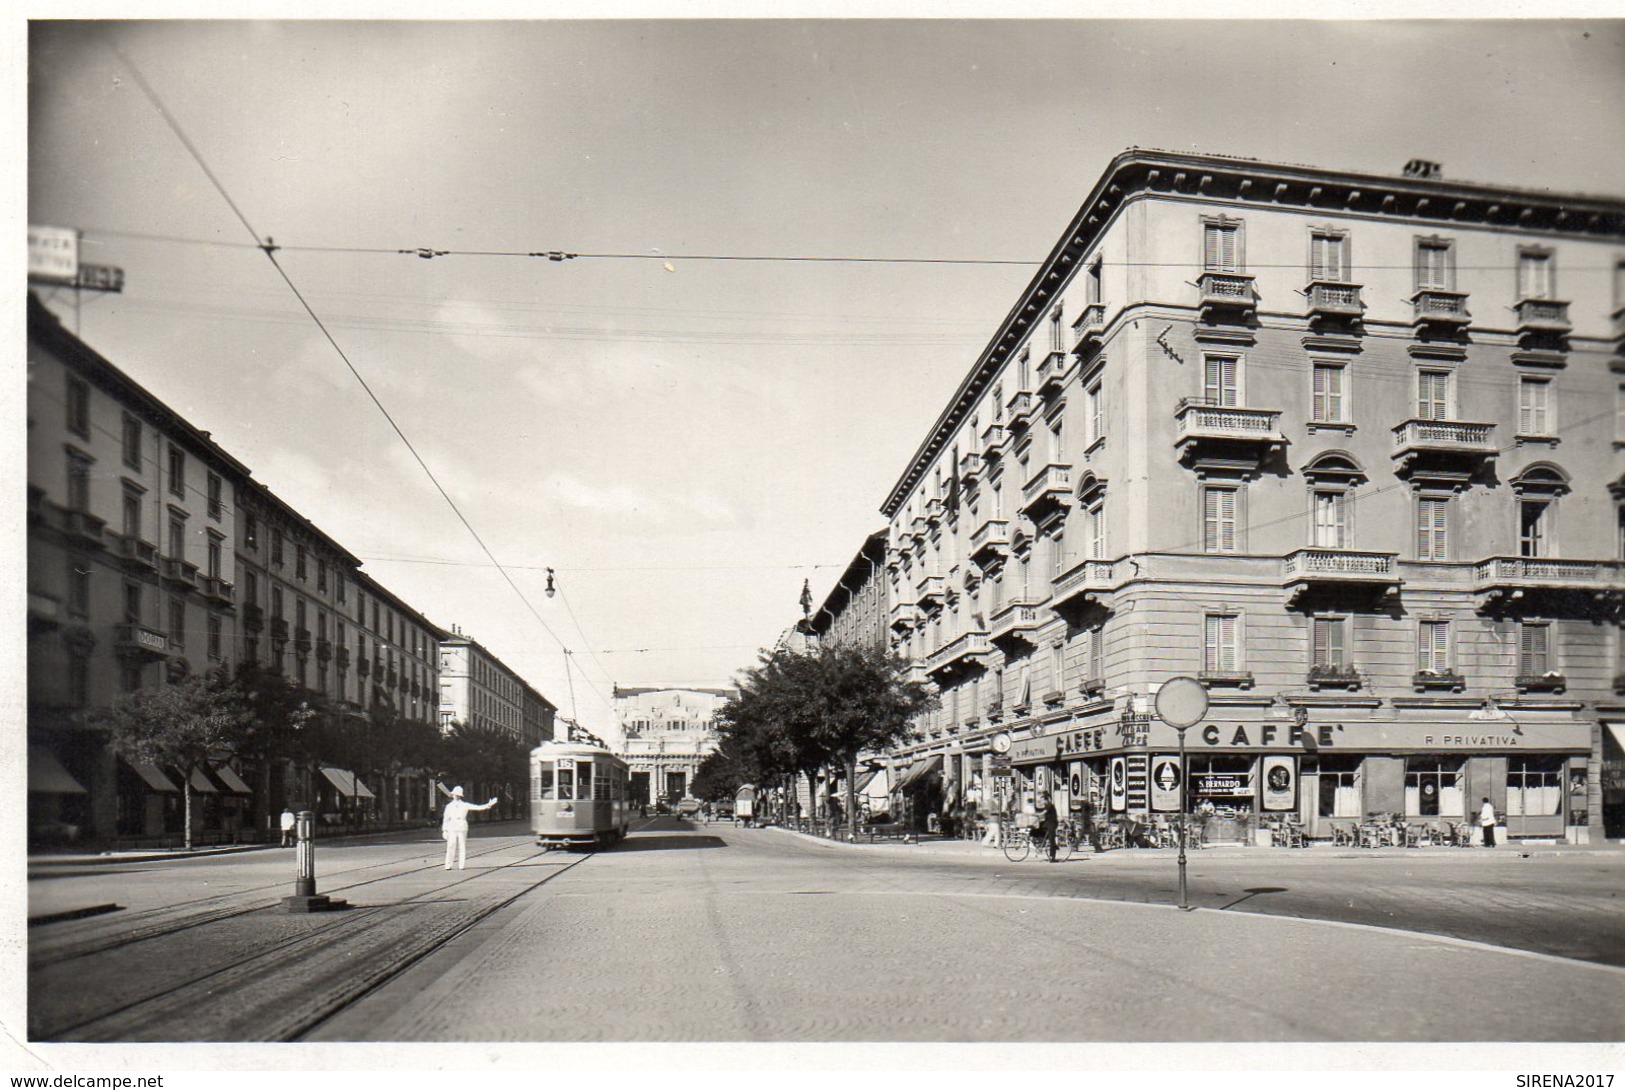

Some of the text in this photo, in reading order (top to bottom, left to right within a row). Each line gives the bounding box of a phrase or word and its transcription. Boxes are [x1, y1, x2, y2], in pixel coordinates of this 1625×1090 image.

[1425, 736, 1517, 745] R. PRIVATIVA
[1205, 780, 1241, 788] BERNARDO
